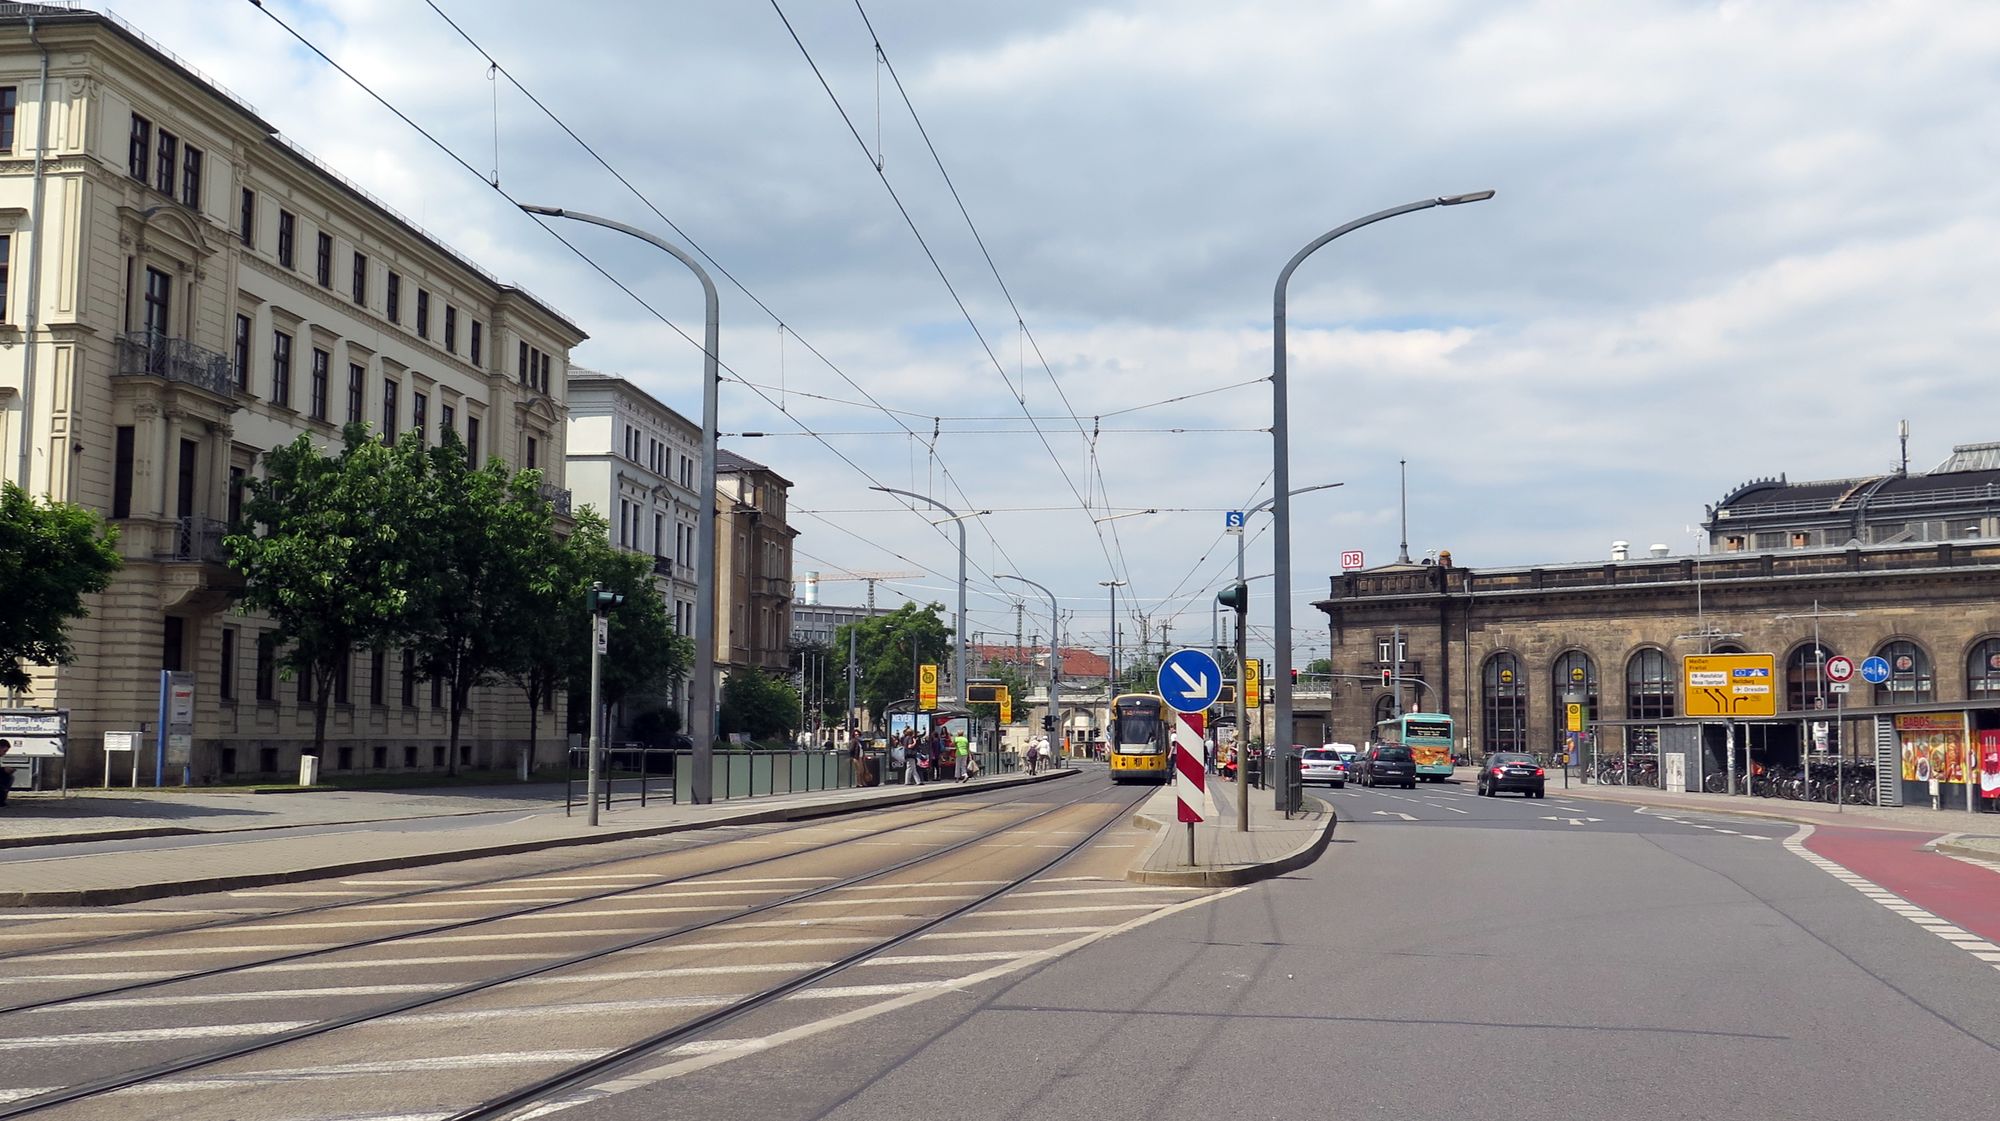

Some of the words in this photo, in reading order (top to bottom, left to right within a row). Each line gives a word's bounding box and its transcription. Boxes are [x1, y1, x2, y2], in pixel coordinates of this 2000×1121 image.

[1229, 513, 1240, 527] S
[1344, 553, 1360, 566] DB
[891, 714, 913, 722] NEVER
